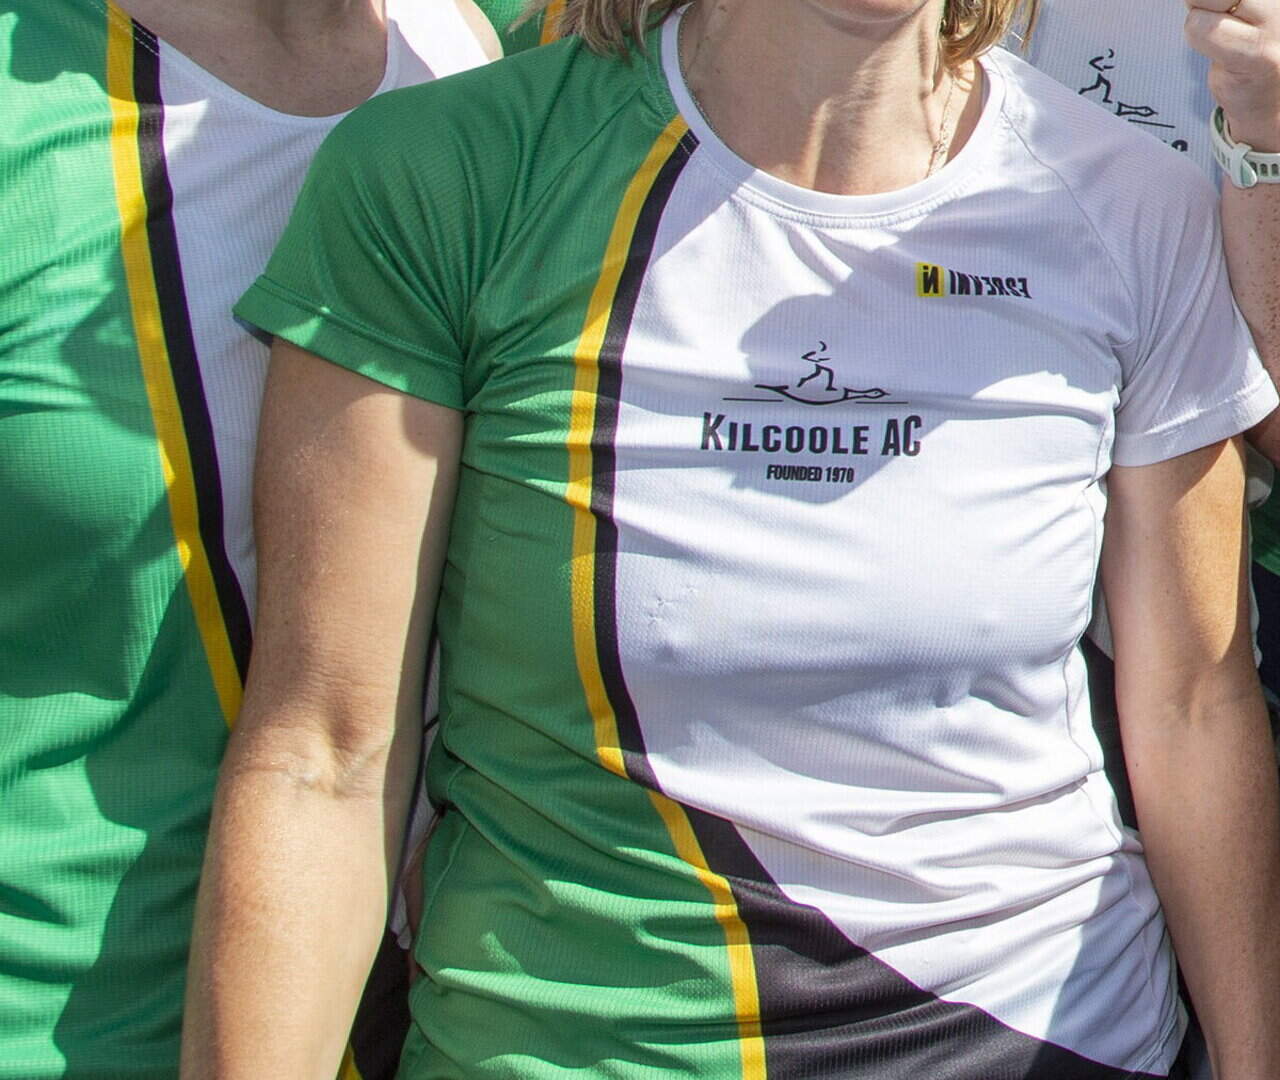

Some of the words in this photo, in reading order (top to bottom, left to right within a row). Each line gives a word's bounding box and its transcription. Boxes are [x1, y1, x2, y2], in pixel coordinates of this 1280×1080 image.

[700, 411, 870, 455] KILCOOLE
[881, 415, 923, 457] AC
[766, 464, 823, 482] FOUNDED
[824, 467, 855, 484] 1970
